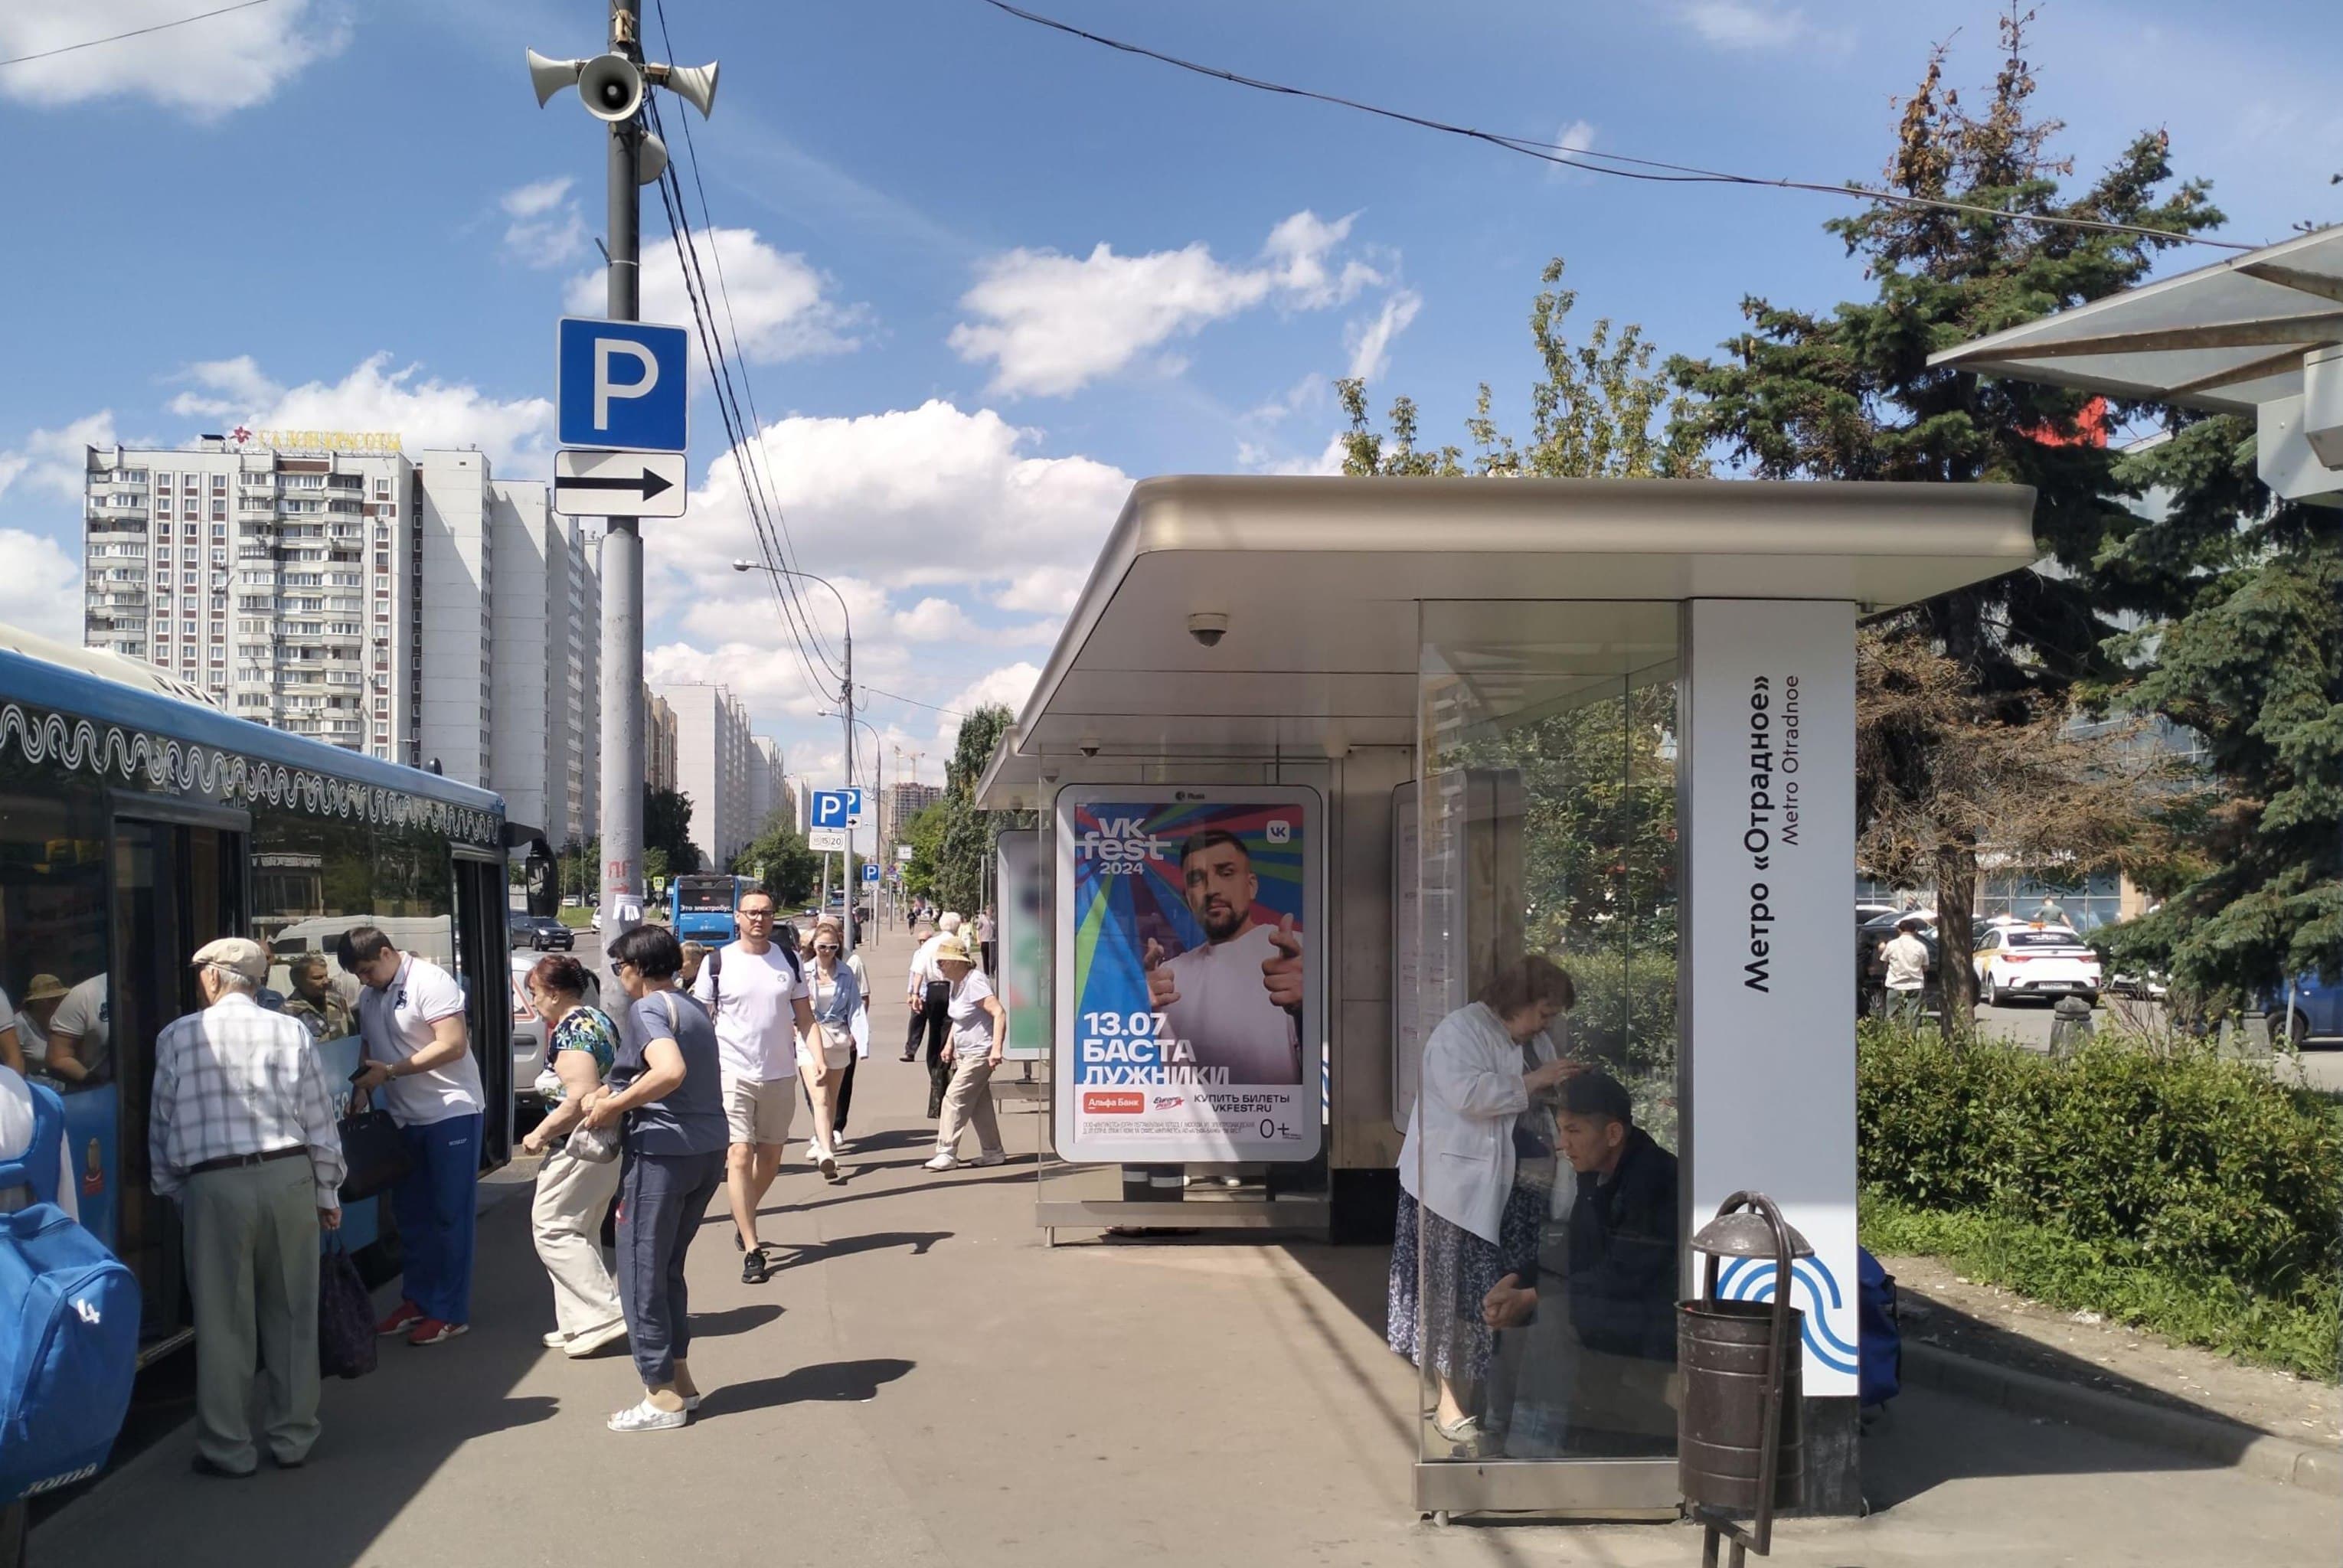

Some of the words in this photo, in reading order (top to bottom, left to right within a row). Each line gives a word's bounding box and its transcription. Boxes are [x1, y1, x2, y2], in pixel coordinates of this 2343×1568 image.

[593, 337, 659, 430] P
[1781, 675, 1799, 773] Otradnoe
[1743, 675, 1775, 871] «Отрадное»
[820, 795, 841, 823] P
[1782, 781, 1799, 845] Metro
[1098, 818, 1146, 838] VK
[831, 838, 841, 846] 20
[1075, 831, 1172, 861] fest
[867, 865, 877, 880] P
[1100, 862, 1145, 874] 2024
[1743, 882, 1775, 993] Метро
[1083, 1011, 1168, 1037] 13.07
[1083, 1038, 1198, 1063] БАСТА
[1083, 1065, 1230, 1086] ЛУЖНИКИ
[1088, 1098, 1117, 1109] Альфа
[1118, 1098, 1140, 1107] Банк
[1194, 1094, 1240, 1103] КУПИТЬ
[1242, 1094, 1290, 1103] БИЛЕТЫ
[1212, 1104, 1272, 1112] VKFEST.RU
[1260, 1118, 1290, 1138] 0+
